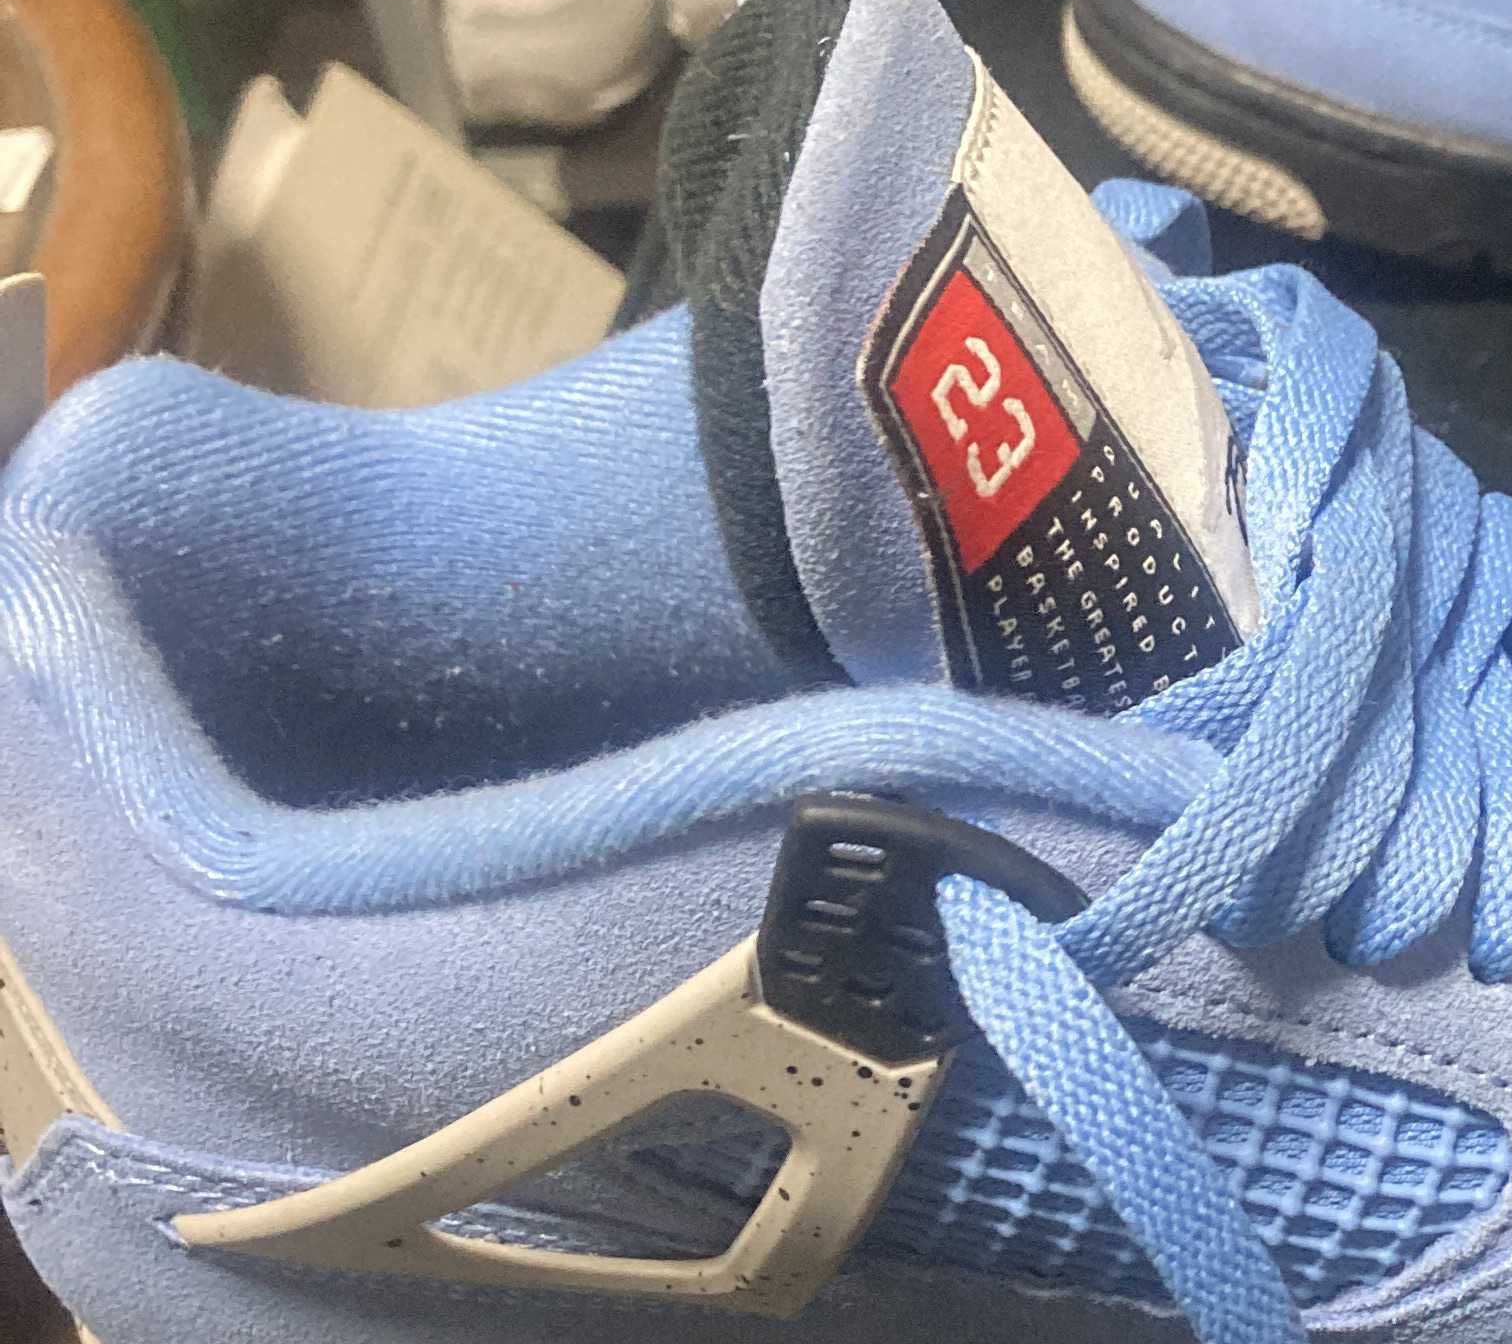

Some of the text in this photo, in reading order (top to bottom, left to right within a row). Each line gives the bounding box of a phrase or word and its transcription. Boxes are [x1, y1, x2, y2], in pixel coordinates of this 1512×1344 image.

[931, 336, 1036, 497] 23
[1016, 544, 1089, 711] BASKETBA
[1048, 516, 1134, 707] THE GREATES
[1070, 489, 1156, 653] INSPIRED
[1090, 464, 1199, 662] PRODUCT
